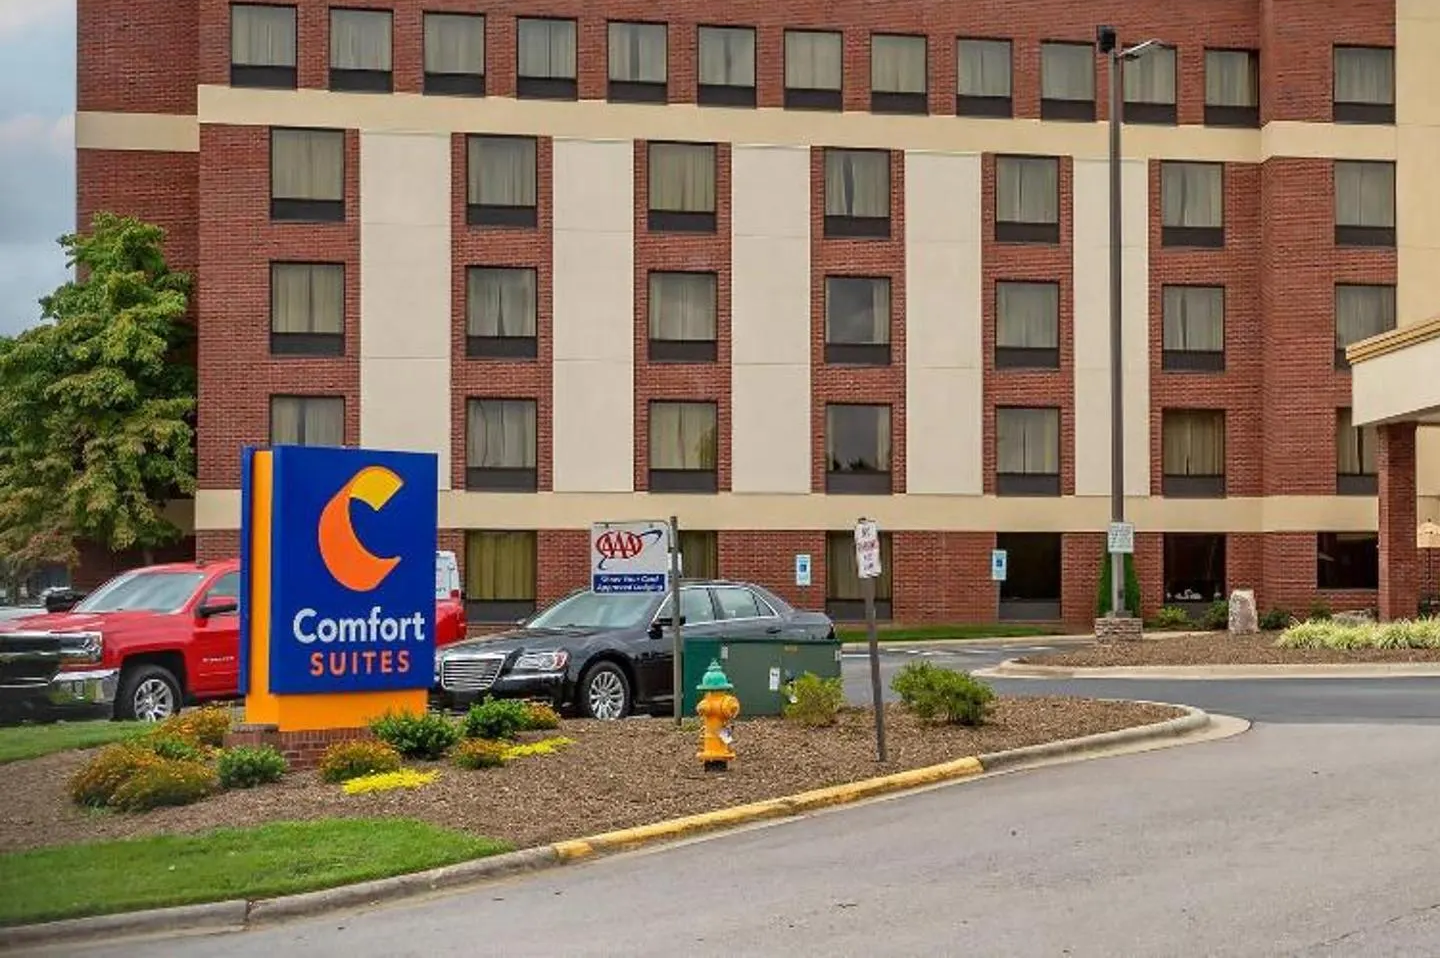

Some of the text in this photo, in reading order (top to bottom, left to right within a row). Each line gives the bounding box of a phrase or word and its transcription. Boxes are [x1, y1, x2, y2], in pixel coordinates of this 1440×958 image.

[600, 531, 640, 559] AAA
[293, 605, 425, 644] Comfort
[310, 649, 410, 676] SUITES
